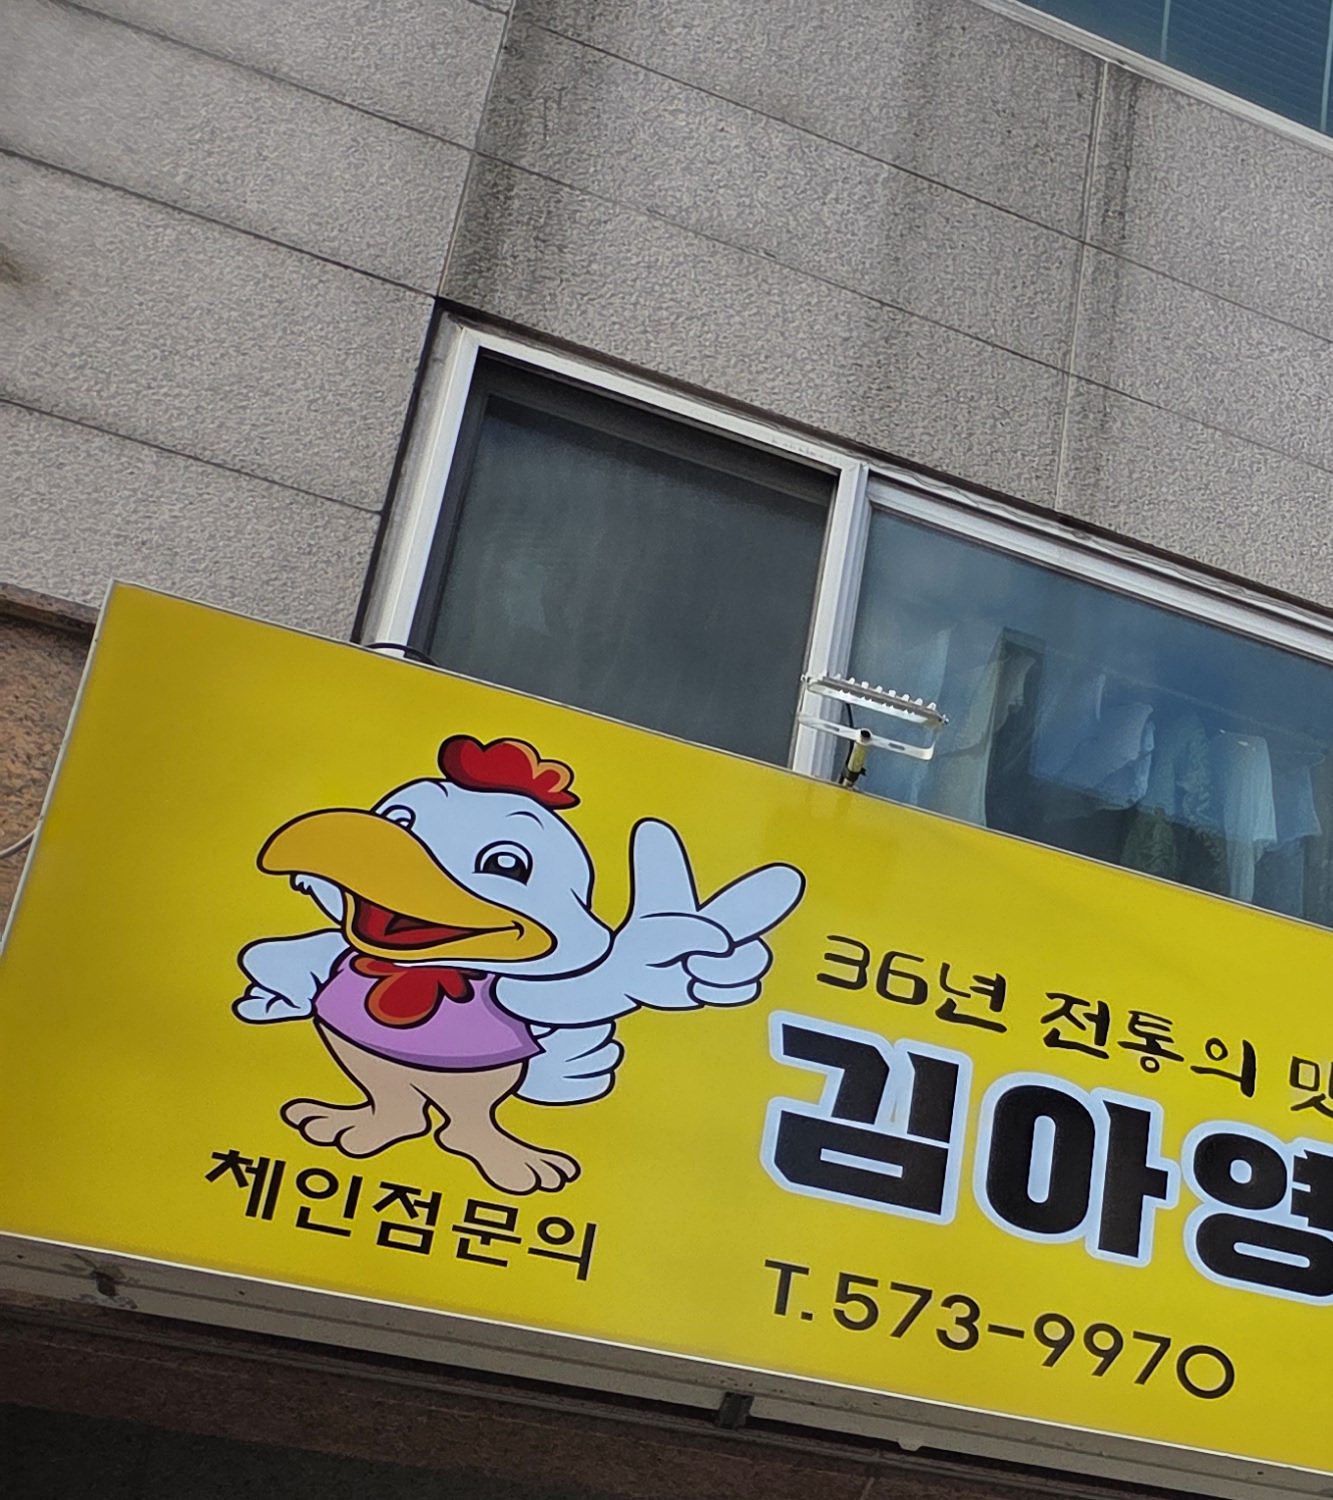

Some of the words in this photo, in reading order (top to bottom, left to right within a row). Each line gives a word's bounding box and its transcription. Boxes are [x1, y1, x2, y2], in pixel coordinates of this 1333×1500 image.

[818, 933, 1008, 1035] 36년
[1042, 990, 1258, 1099] 전통의
[204, 1150, 598, 1281] 체인점문의
